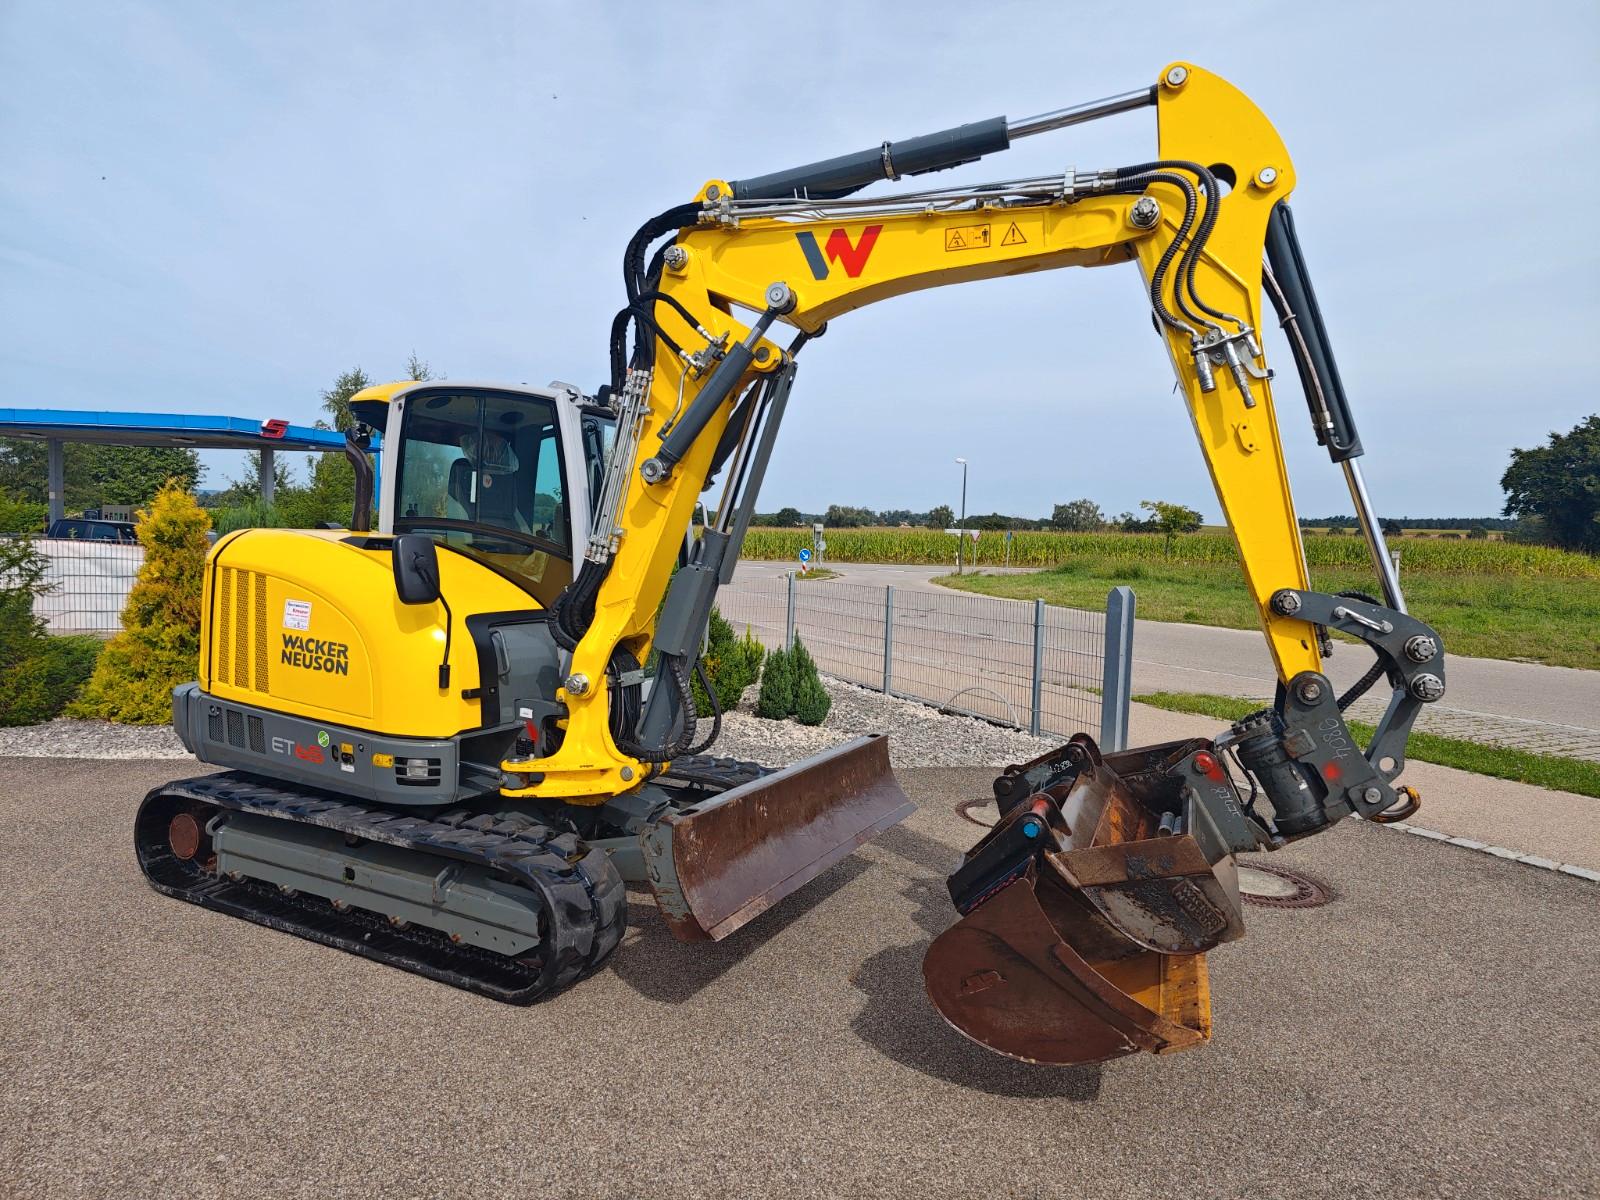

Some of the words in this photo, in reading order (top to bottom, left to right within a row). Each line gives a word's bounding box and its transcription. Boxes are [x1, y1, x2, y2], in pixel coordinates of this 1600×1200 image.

[282, 633, 349, 660] WACKER
[281, 649, 349, 676] NEUSON
[1319, 718, 1351, 760] 9804
